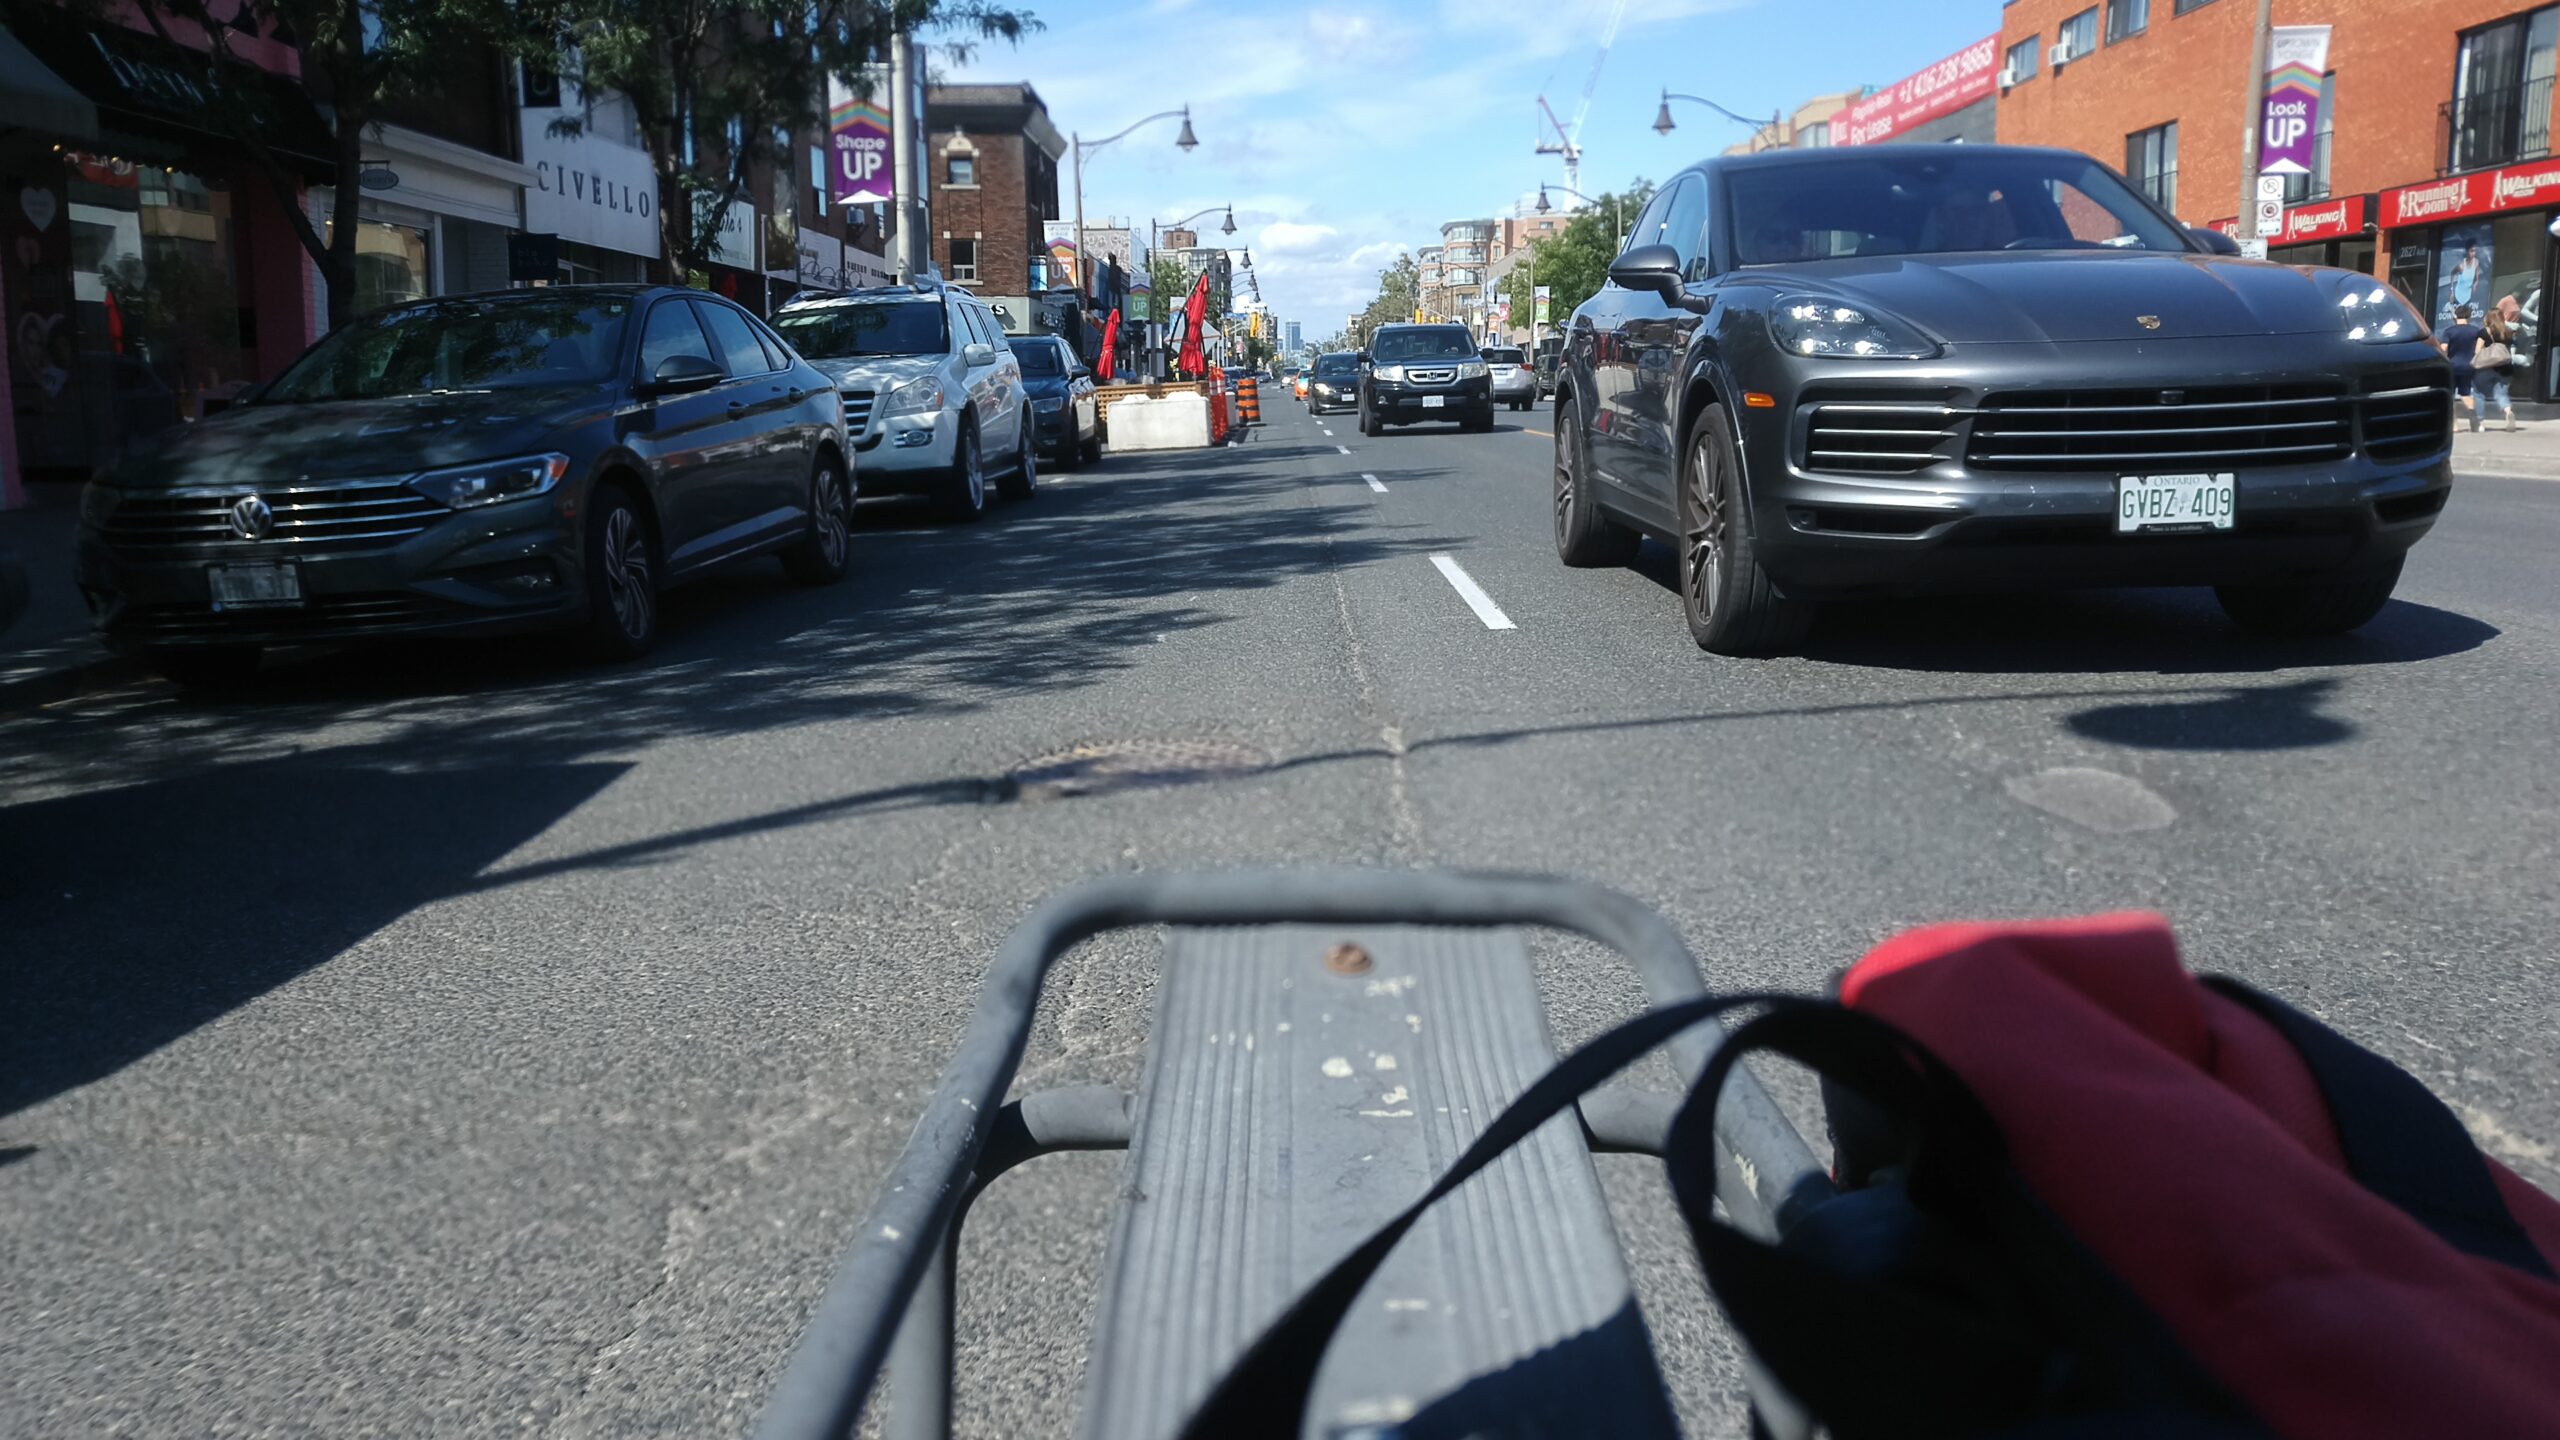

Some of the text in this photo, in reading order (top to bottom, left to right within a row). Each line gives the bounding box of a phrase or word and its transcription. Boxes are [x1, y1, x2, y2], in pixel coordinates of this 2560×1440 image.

[2267, 100, 2307, 116] Look
[835, 133, 887, 152] Shape
[2266, 118, 2307, 149] UP
[842, 150, 883, 181] UP
[536, 160, 650, 219] CIVELLO
[1051, 263, 1072, 279] UP
[1133, 301, 1147, 312] UP
[2153, 476, 2201, 486] ONTARIO
[2122, 487, 2232, 518] GVBZ 409
